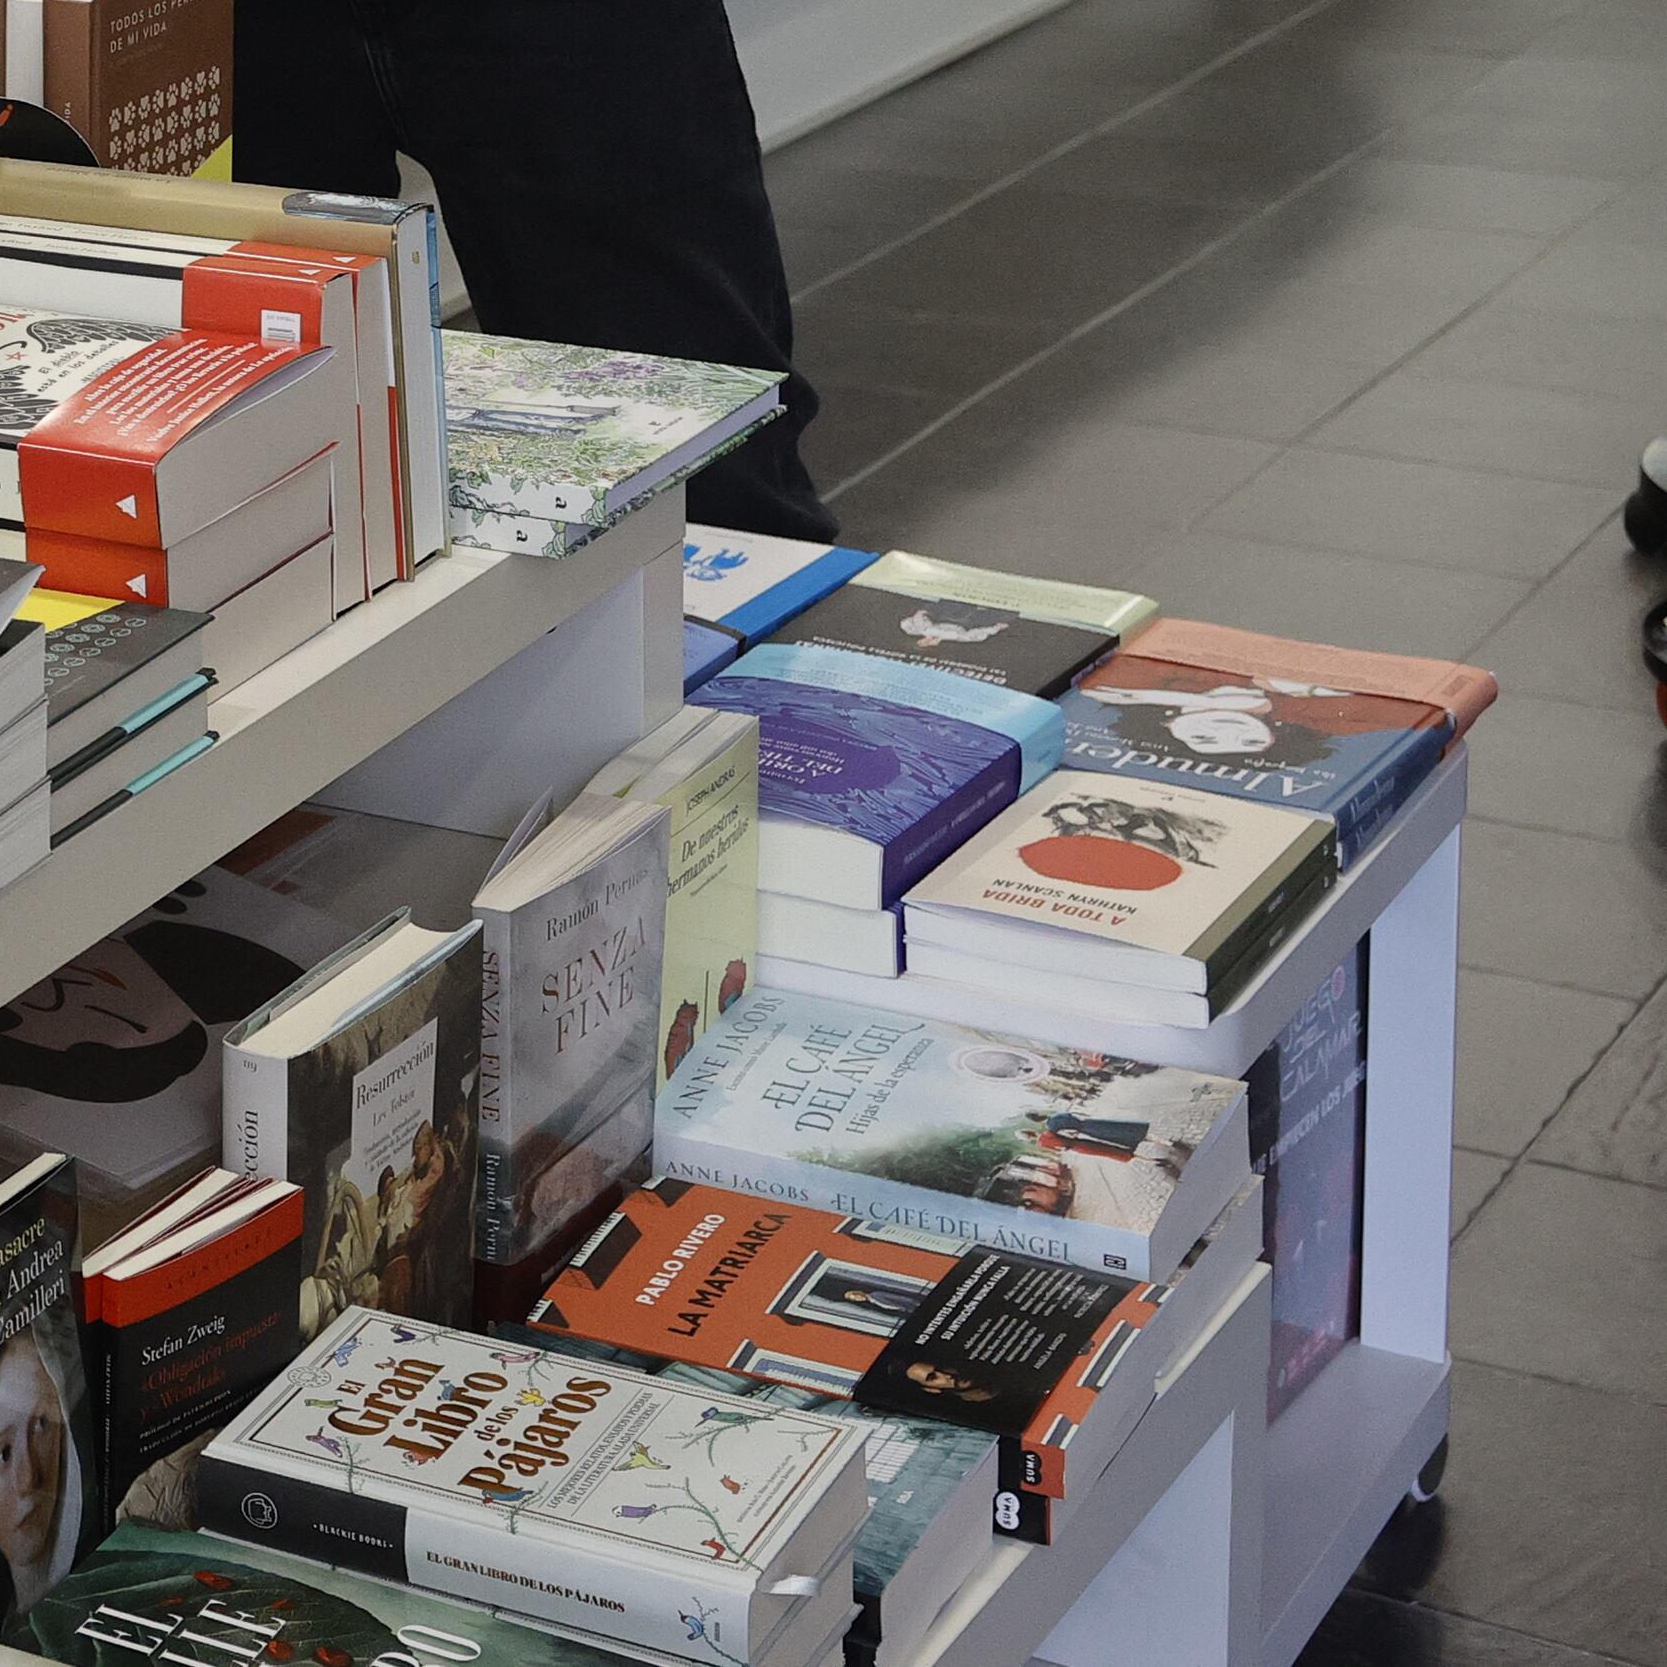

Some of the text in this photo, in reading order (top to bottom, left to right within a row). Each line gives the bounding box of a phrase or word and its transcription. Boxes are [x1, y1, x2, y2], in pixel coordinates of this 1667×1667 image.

[109, 22, 167, 54] DE MI VIDA
[110, 13, 144, 33] TODOS
[147, 0, 167, 19] LOS
[667, 816, 750, 897] hermanos heridos
[680, 804, 739, 862] De nuestros
[545, 896, 599, 942] Ramón
[982, 888, 1126, 928] A TODA BRIDA
[991, 877, 1136, 915] KATHRYN SCANLAN
[540, 917, 646, 1014] SENZA
[554, 968, 637, 1057] FINE
[356, 1038, 435, 1109] Resurrección
[482, 949, 501, 1213] SENZA FINE Ramón
[670, 996, 785, 1118] ANNE JACOBS
[761, 1025, 851, 1106] EL CAFÉ
[792, 1022, 926, 1131] DEL ÁNGEL
[845, 1038, 935, 1135] Hijas de la esperanza
[666, 1159, 1075, 1264] ANNE JACOBS EL CAFÉ DEL ÁNGEL
[5, 1239, 64, 1301] Andrea
[636, 1215, 723, 1304] PABLO RIVERO
[669, 1214, 791, 1337] LA MATRIARCA
[142, 1315, 225, 1366] Stefan Zweig
[326, 1356, 442, 1439] Gran
[341, 1379, 366, 1398] El
[383, 1368, 509, 1462] Libro
[476, 1403, 518, 1443] de los
[461, 1375, 612, 1496] Pájaros
[426, 1551, 625, 1613] EL GRAN LIBRO DE LOS PÁJAROS
